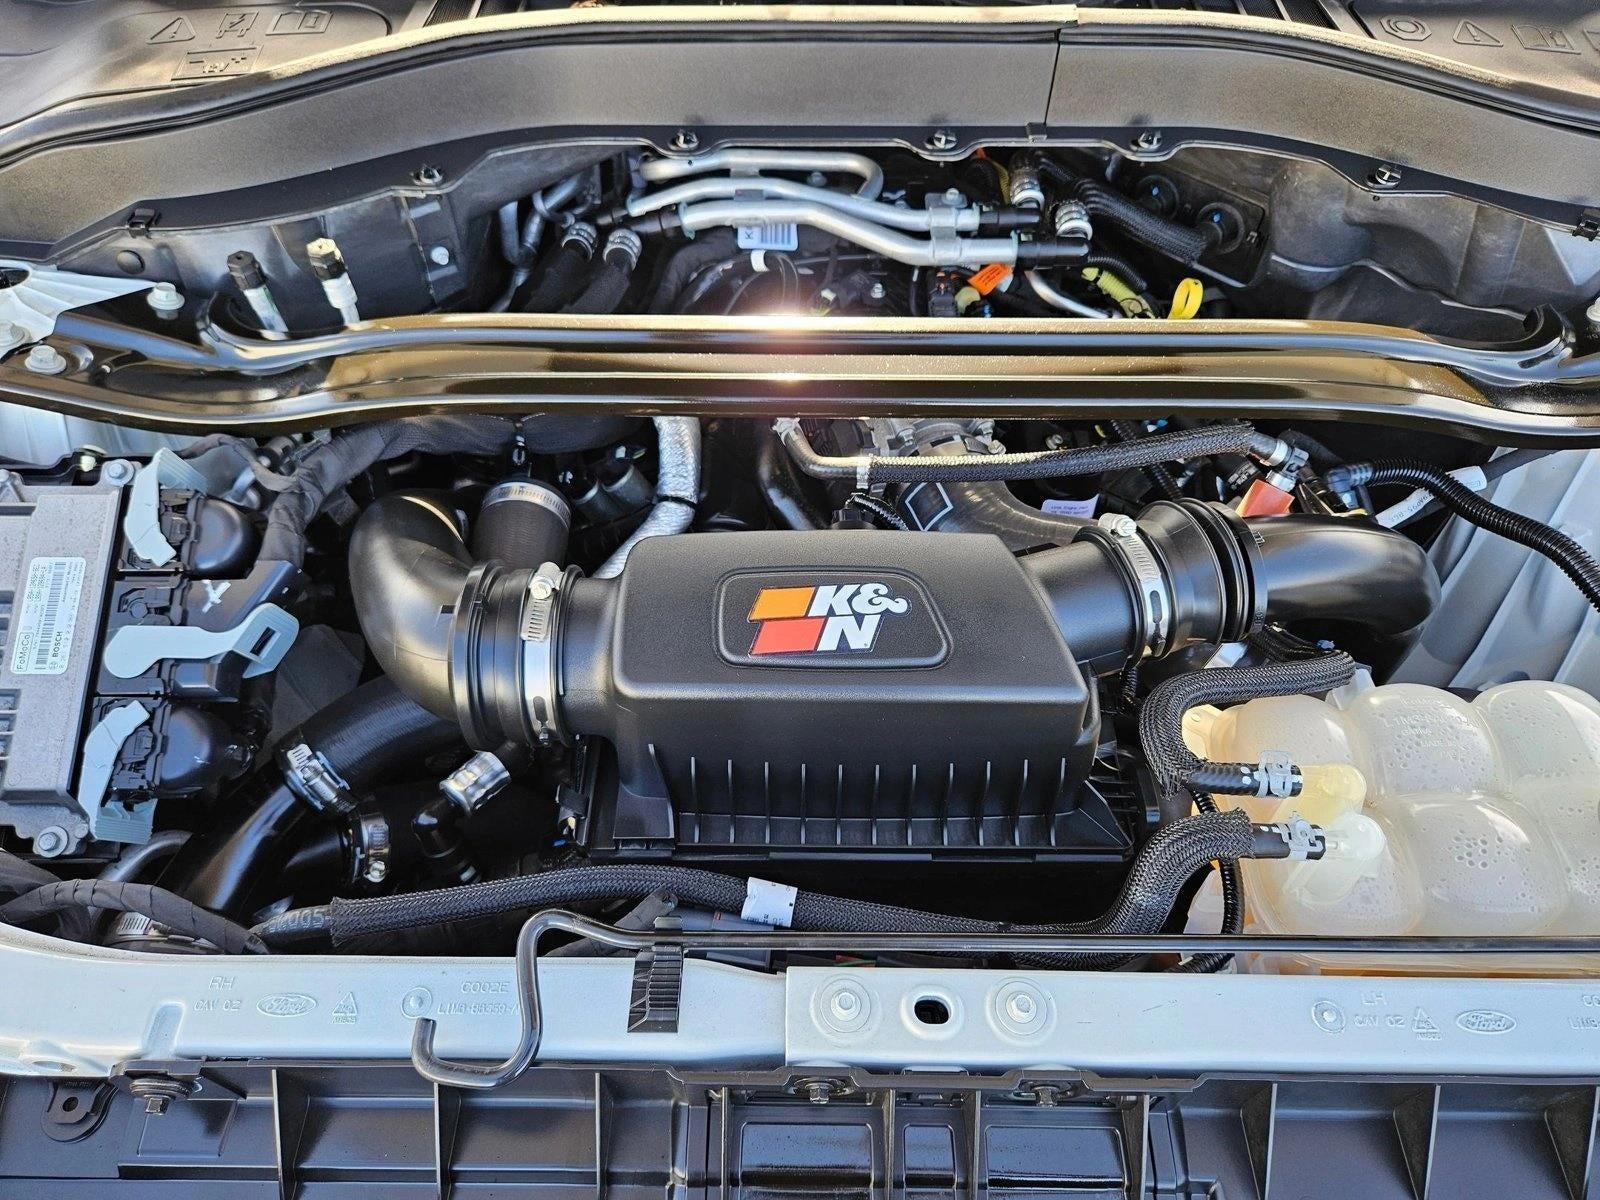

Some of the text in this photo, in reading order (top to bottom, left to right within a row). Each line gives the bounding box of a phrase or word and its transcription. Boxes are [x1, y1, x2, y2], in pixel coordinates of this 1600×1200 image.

[16, 634, 30, 670] FoMoCo
[52, 631, 63, 658] BOSCH
[209, 975, 236, 990] RH
